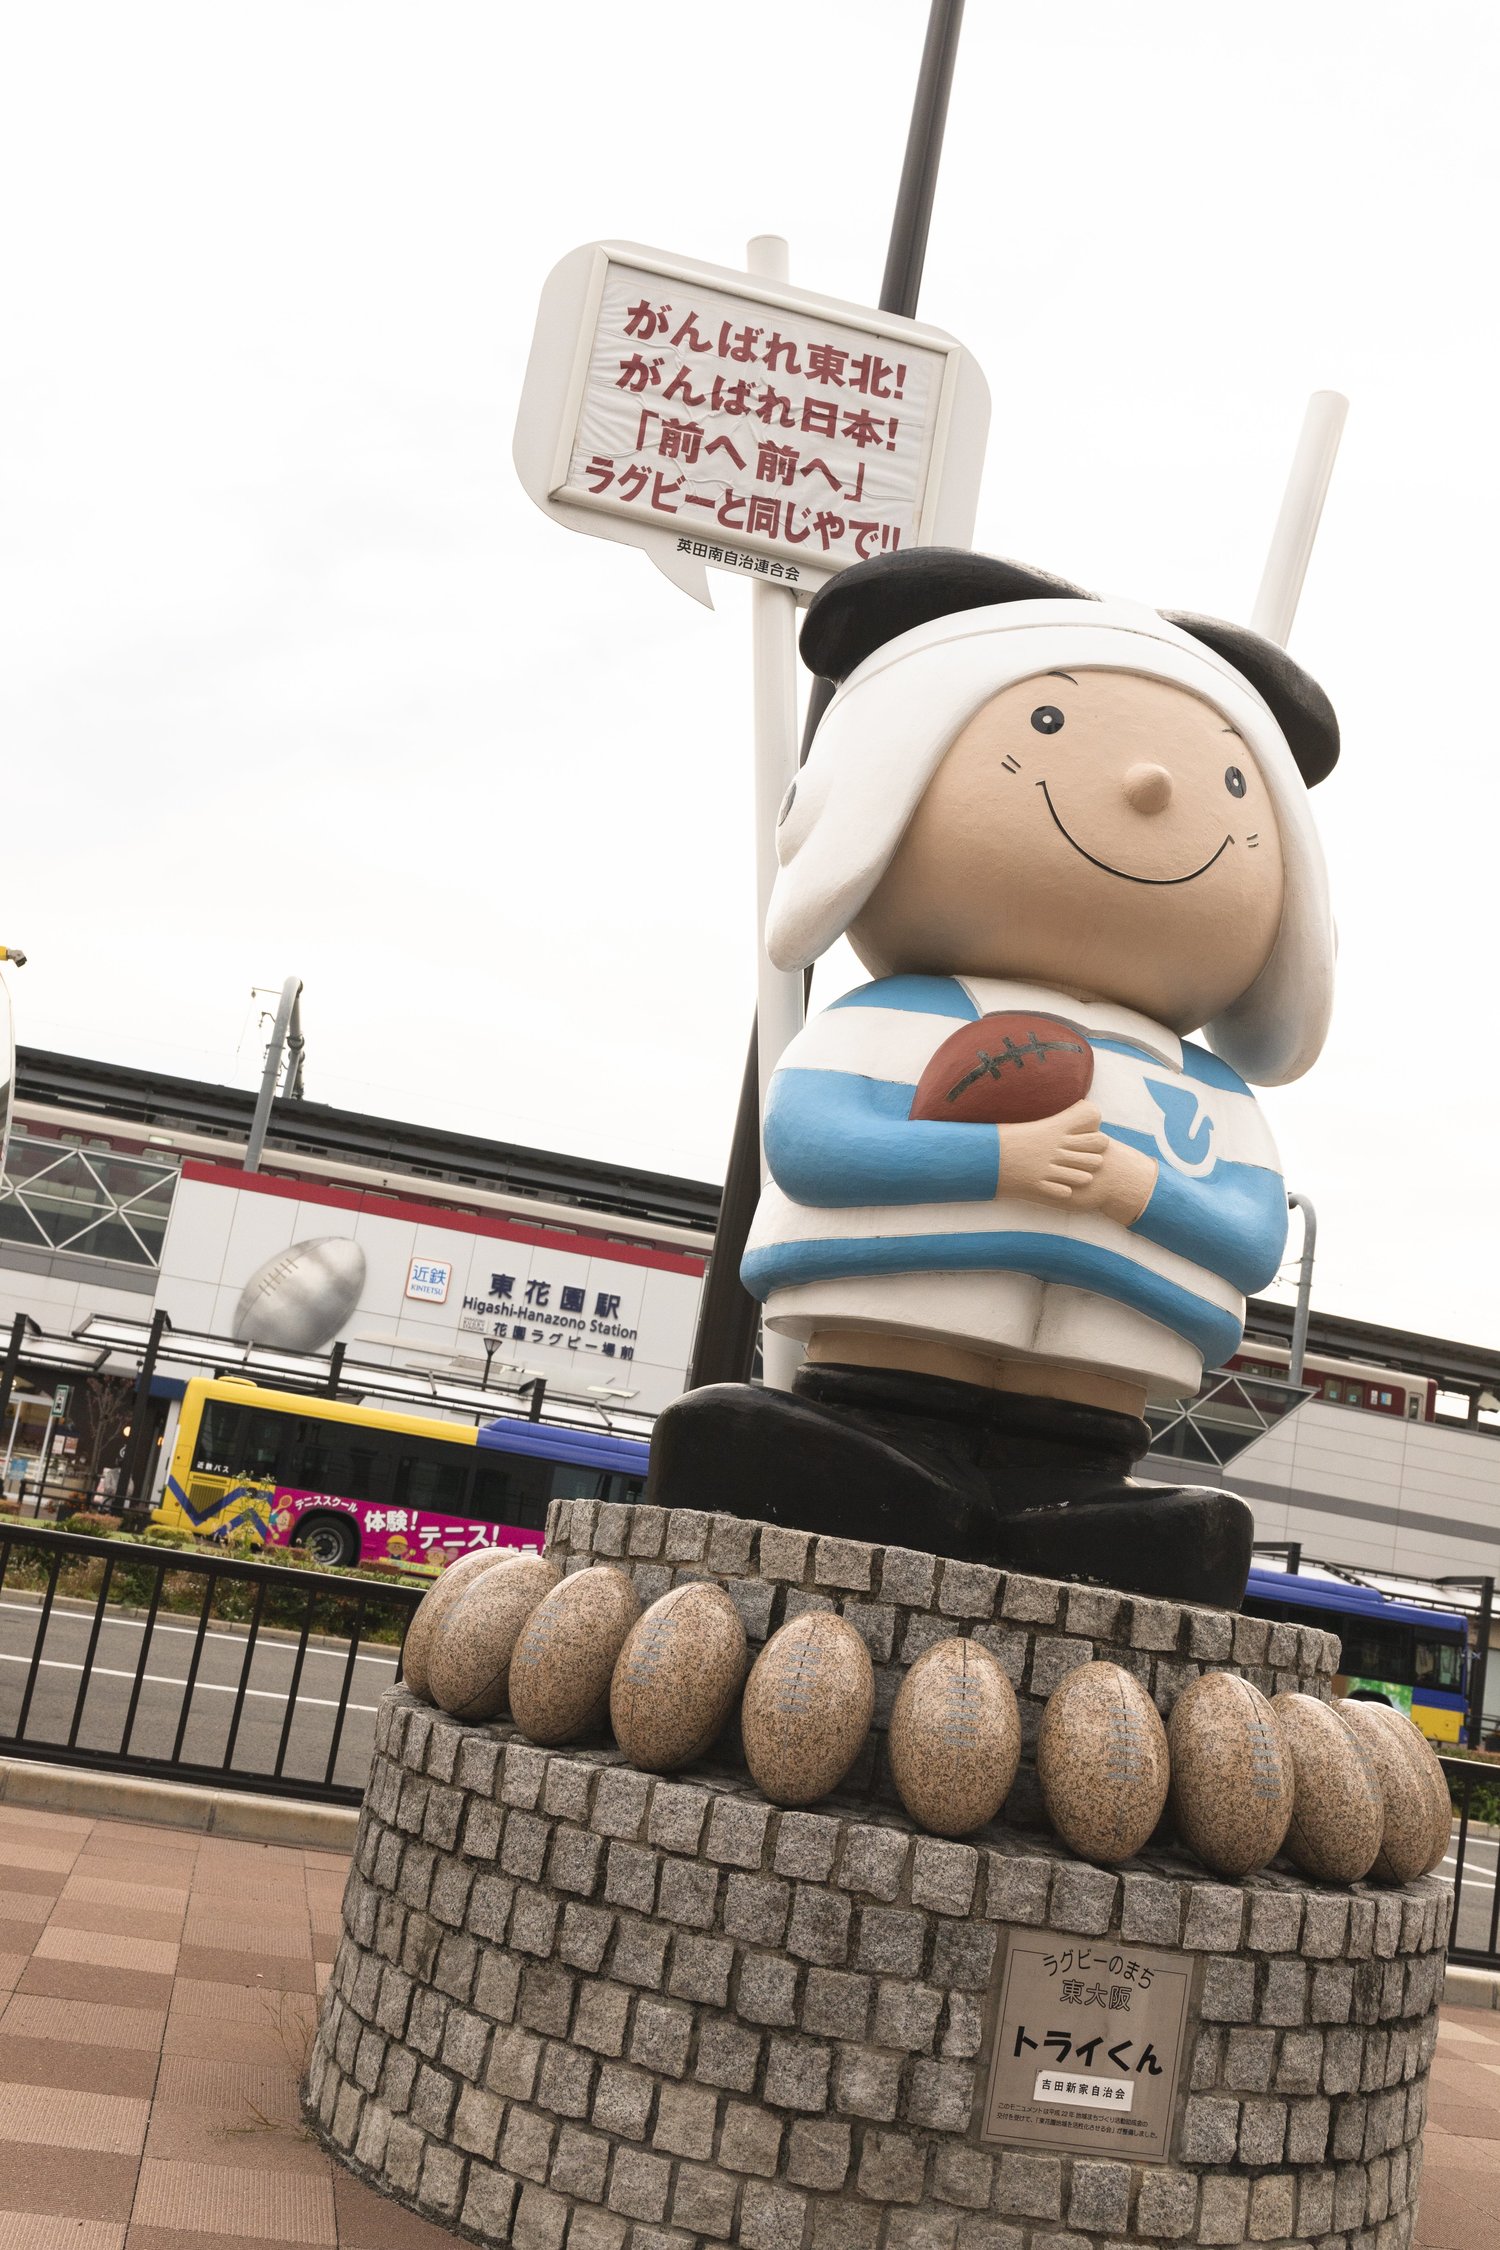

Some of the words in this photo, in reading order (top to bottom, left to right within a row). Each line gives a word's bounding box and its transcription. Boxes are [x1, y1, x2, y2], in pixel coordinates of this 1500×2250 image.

[622, 299, 907, 400] がんばれ東北!
[615, 353, 899, 452] がんばれ日本!
[585, 455, 902, 559] ラグビーと同じやで!!
[677, 538, 800, 582] 英田南自治連合会
[410, 1283, 443, 1296] KINTETSU
[412, 1264, 447, 1286] 近鉄
[488, 1273, 622, 1319] 東花園駅
[462, 1295, 586, 1331] Higashi-Hanazono
[589, 1319, 638, 1341] Station
[493, 1322, 634, 1361] 花園ラグビー場前
[196, 1460, 230, 1474] 近鉄バス
[294, 1495, 358, 1514] テニススクール
[364, 1509, 419, 1533] 体験!
[418, 1524, 500, 1549] テニス!
[1043, 1948, 1155, 1990] ラグビーのまち
[1060, 1979, 1132, 2012] 東大阪
[1013, 2025, 1163, 2076] トライくん
[1041, 2078, 1126, 2100] 吉田新家自治会
